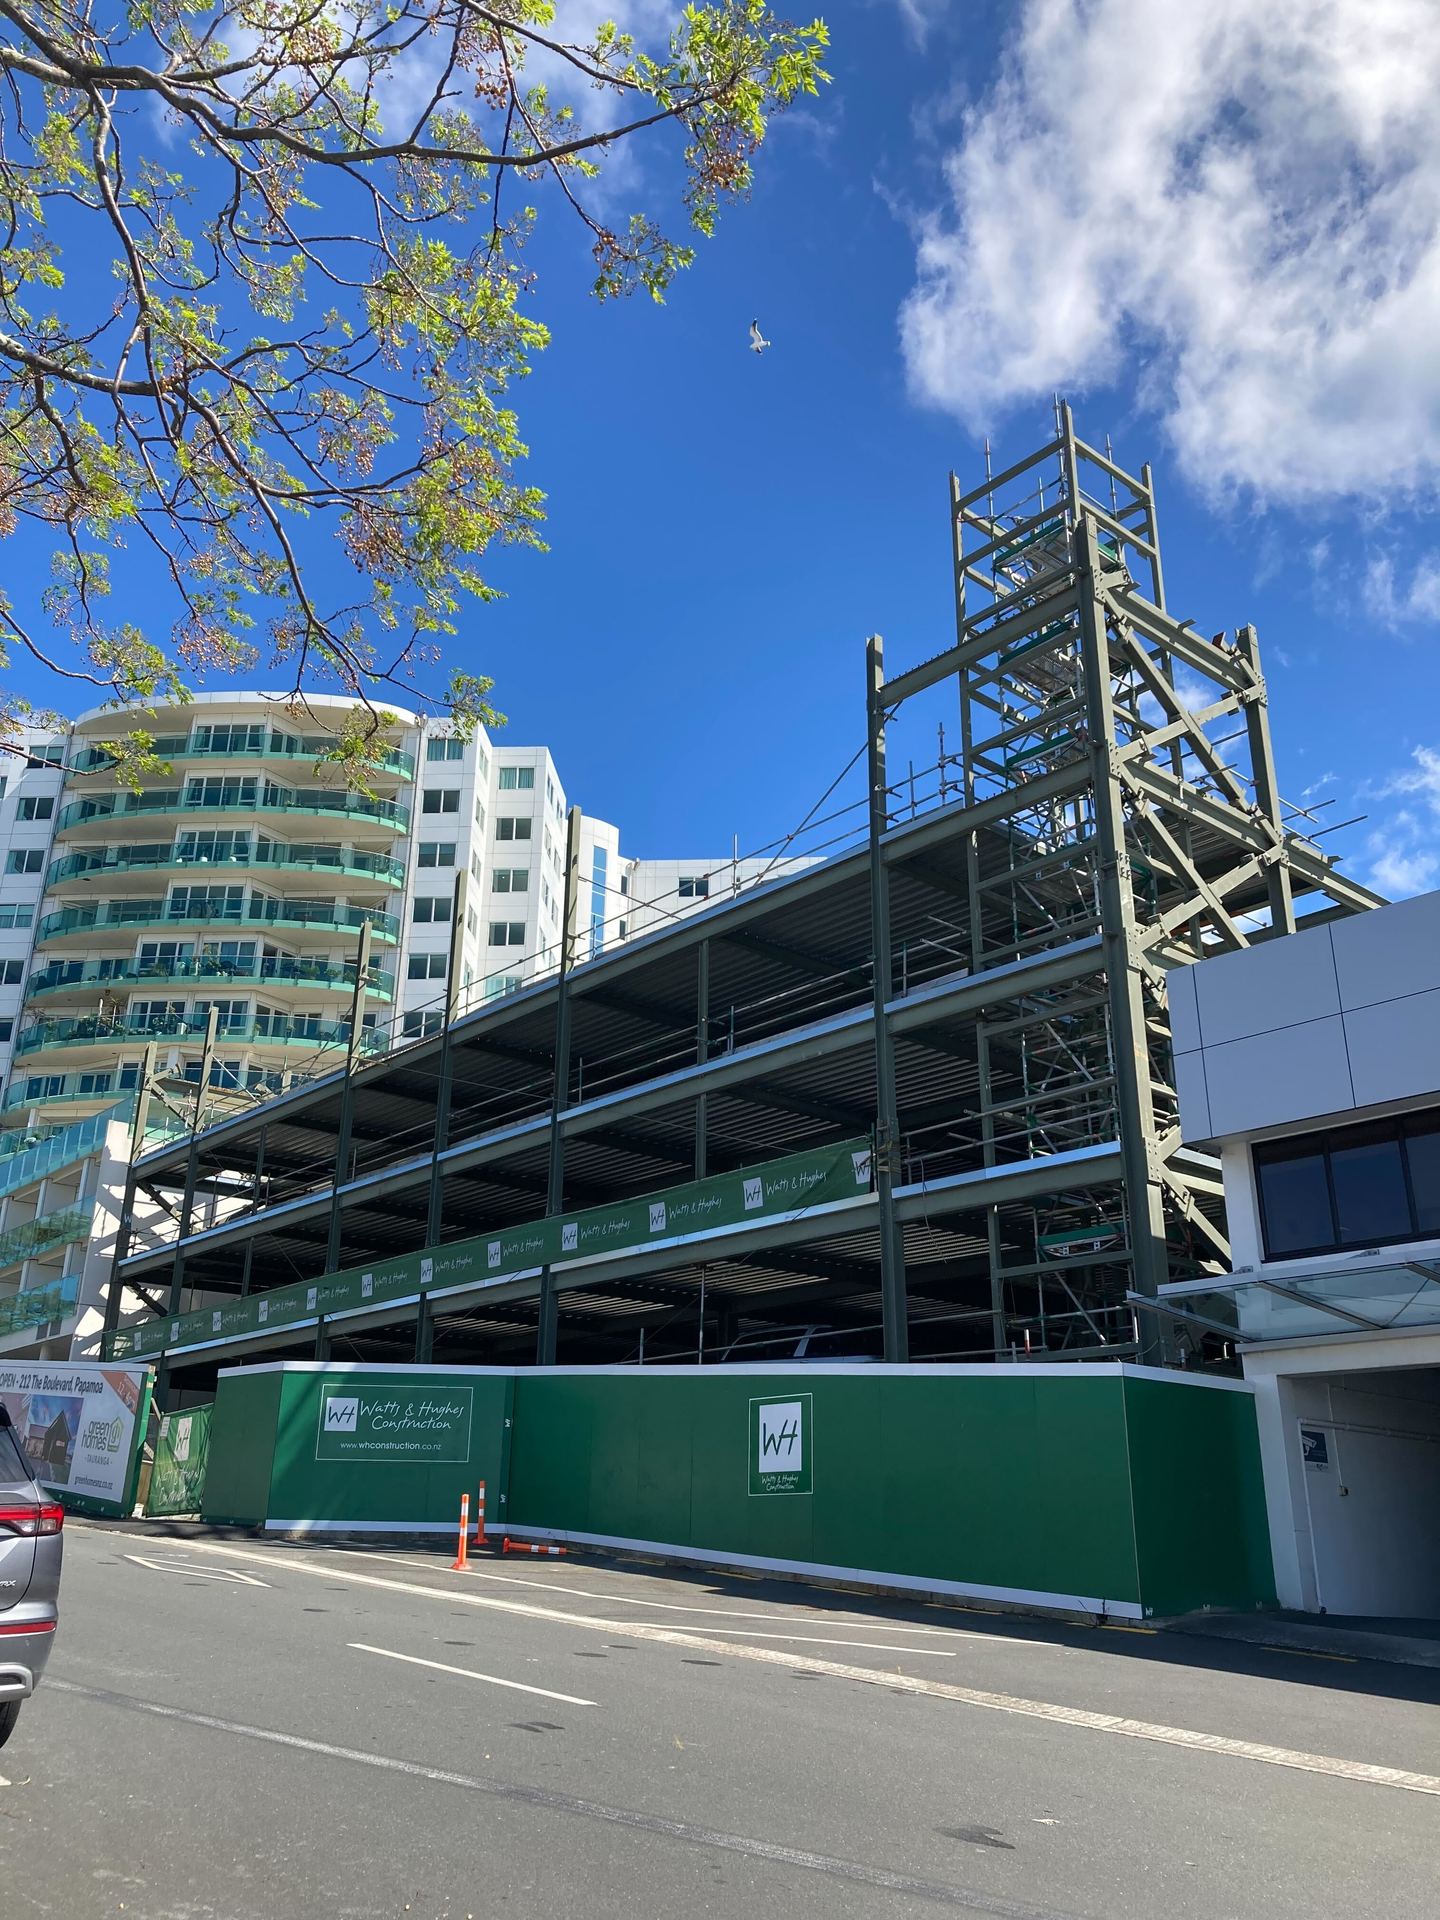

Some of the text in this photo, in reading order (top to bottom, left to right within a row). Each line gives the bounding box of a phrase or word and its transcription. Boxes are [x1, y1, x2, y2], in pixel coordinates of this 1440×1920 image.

[745, 1169, 827, 1203] WH Watts & Hughes
[650, 1195, 722, 1226] WH Watts & Hughes
[563, 1217, 631, 1245] WH Watts & Hughes
[489, 1247, 500, 1263] WH
[19, 1374, 31, 1389] 212
[31, 1374, 41, 1390] The
[42, 1375, 74, 1394] Boulevard,
[74, 1377, 103, 1395] Papamoa
[328, 1405, 355, 1424] WH
[360, 1401, 465, 1421] Watts & Hughes
[89, 1420, 109, 1437] green
[372, 1415, 452, 1432] Construction
[81, 1429, 107, 1451] homes
[340, 1441, 442, 1451] www.whconstruction.co.nz
[763, 1419, 798, 1456] WH
[87, 1454, 110, 1466] TAURANGA
